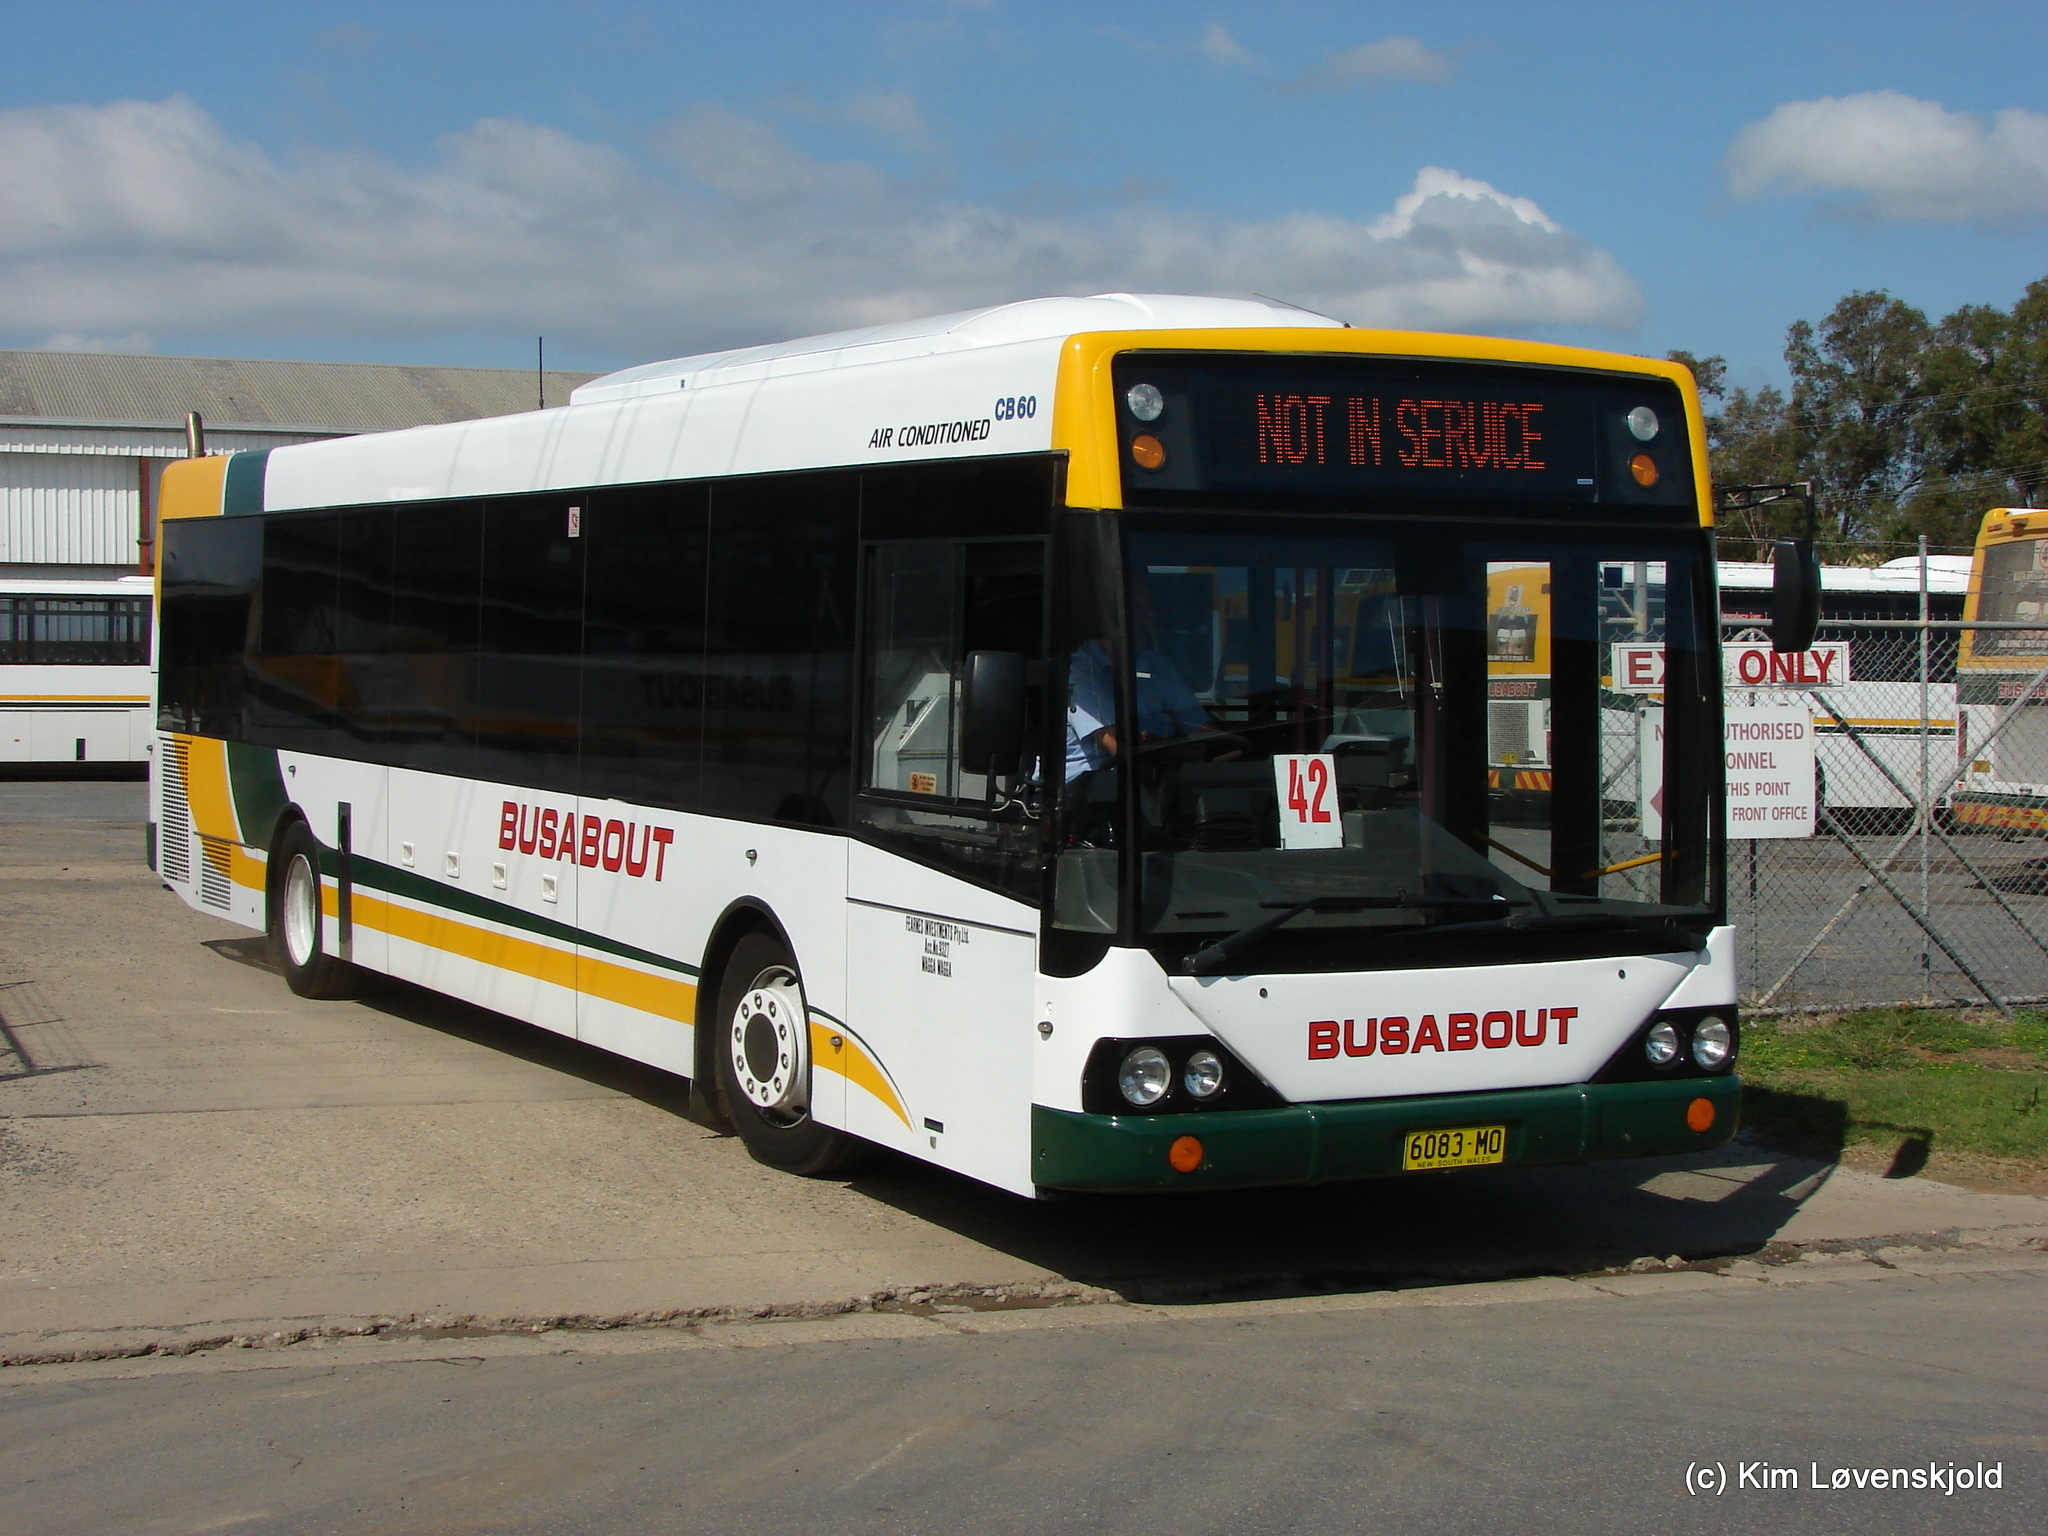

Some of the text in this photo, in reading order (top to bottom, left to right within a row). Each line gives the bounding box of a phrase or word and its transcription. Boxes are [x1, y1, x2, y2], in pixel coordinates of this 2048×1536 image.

[994, 395, 1037, 421] CB60
[868, 418, 991, 448] AIR CONDITIONED
[1257, 394, 1546, 469] NOT IN SERVICE
[1739, 650, 1837, 684] ONLY
[1488, 682, 1537, 697] USABOUT
[1724, 723, 1804, 741] UTHORISED
[1726, 752, 1776, 770] ONNEL
[1288, 758, 1331, 823] 42
[1755, 782, 1790, 796] POINT
[1732, 806, 1808, 821] FRONT OFFICE
[498, 801, 675, 882] BUSABOUT
[1308, 1007, 1578, 1060] BUSABOUT
[1438, 1159, 1462, 1167] SOUTH
[1467, 1156, 1491, 1164] WALES
